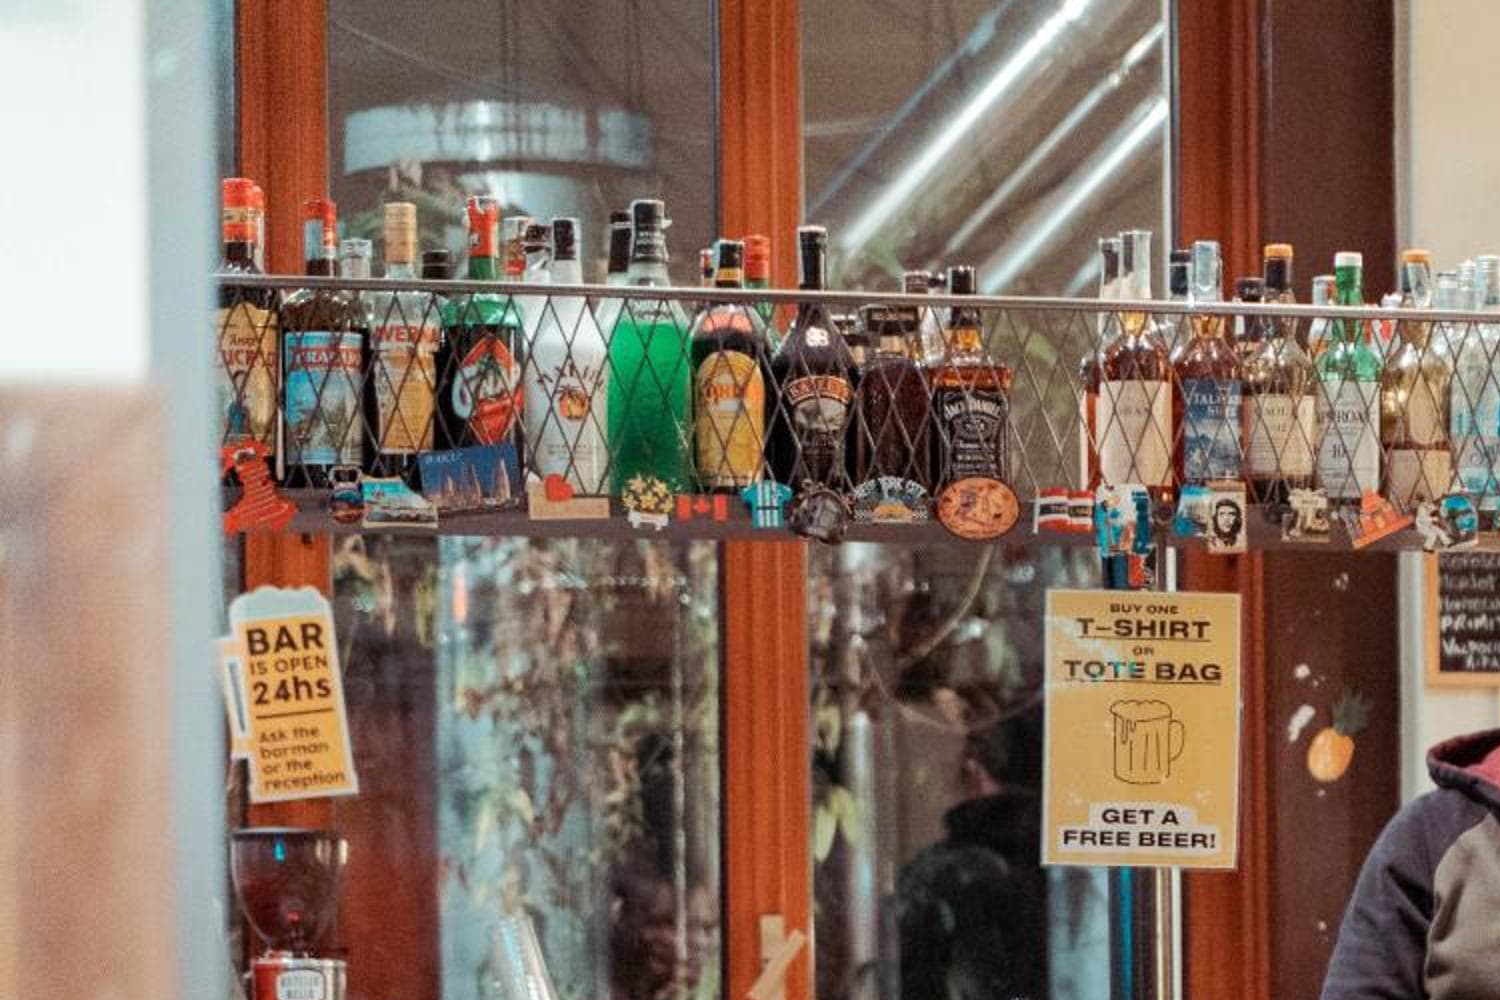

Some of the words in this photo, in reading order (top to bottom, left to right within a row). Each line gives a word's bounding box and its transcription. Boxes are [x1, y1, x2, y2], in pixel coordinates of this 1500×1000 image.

[1110, 604, 1142, 615] BUY
[1147, 604, 1178, 615] ONE
[1076, 618, 1211, 639] T-SHIRT
[246, 622, 324, 656] BAR
[1133, 645, 1155, 656] OR
[251, 662, 268, 676] IS
[275, 655, 328, 674] OPEN
[1062, 659, 1146, 679] TOTE
[1156, 662, 1223, 681] BAG
[252, 677, 332, 705] 24hs
[259, 729, 286, 744] Ask
[293, 725, 320, 739] the
[260, 741, 329, 760] barman
[263, 763, 282, 775] or
[286, 757, 313, 771] the
[264, 770, 346, 791] reception
[1102, 808, 1155, 825] GET
[1162, 809, 1179, 825] A
[1063, 830, 1131, 847] FREE
[1139, 832, 1216, 849] BEER!
